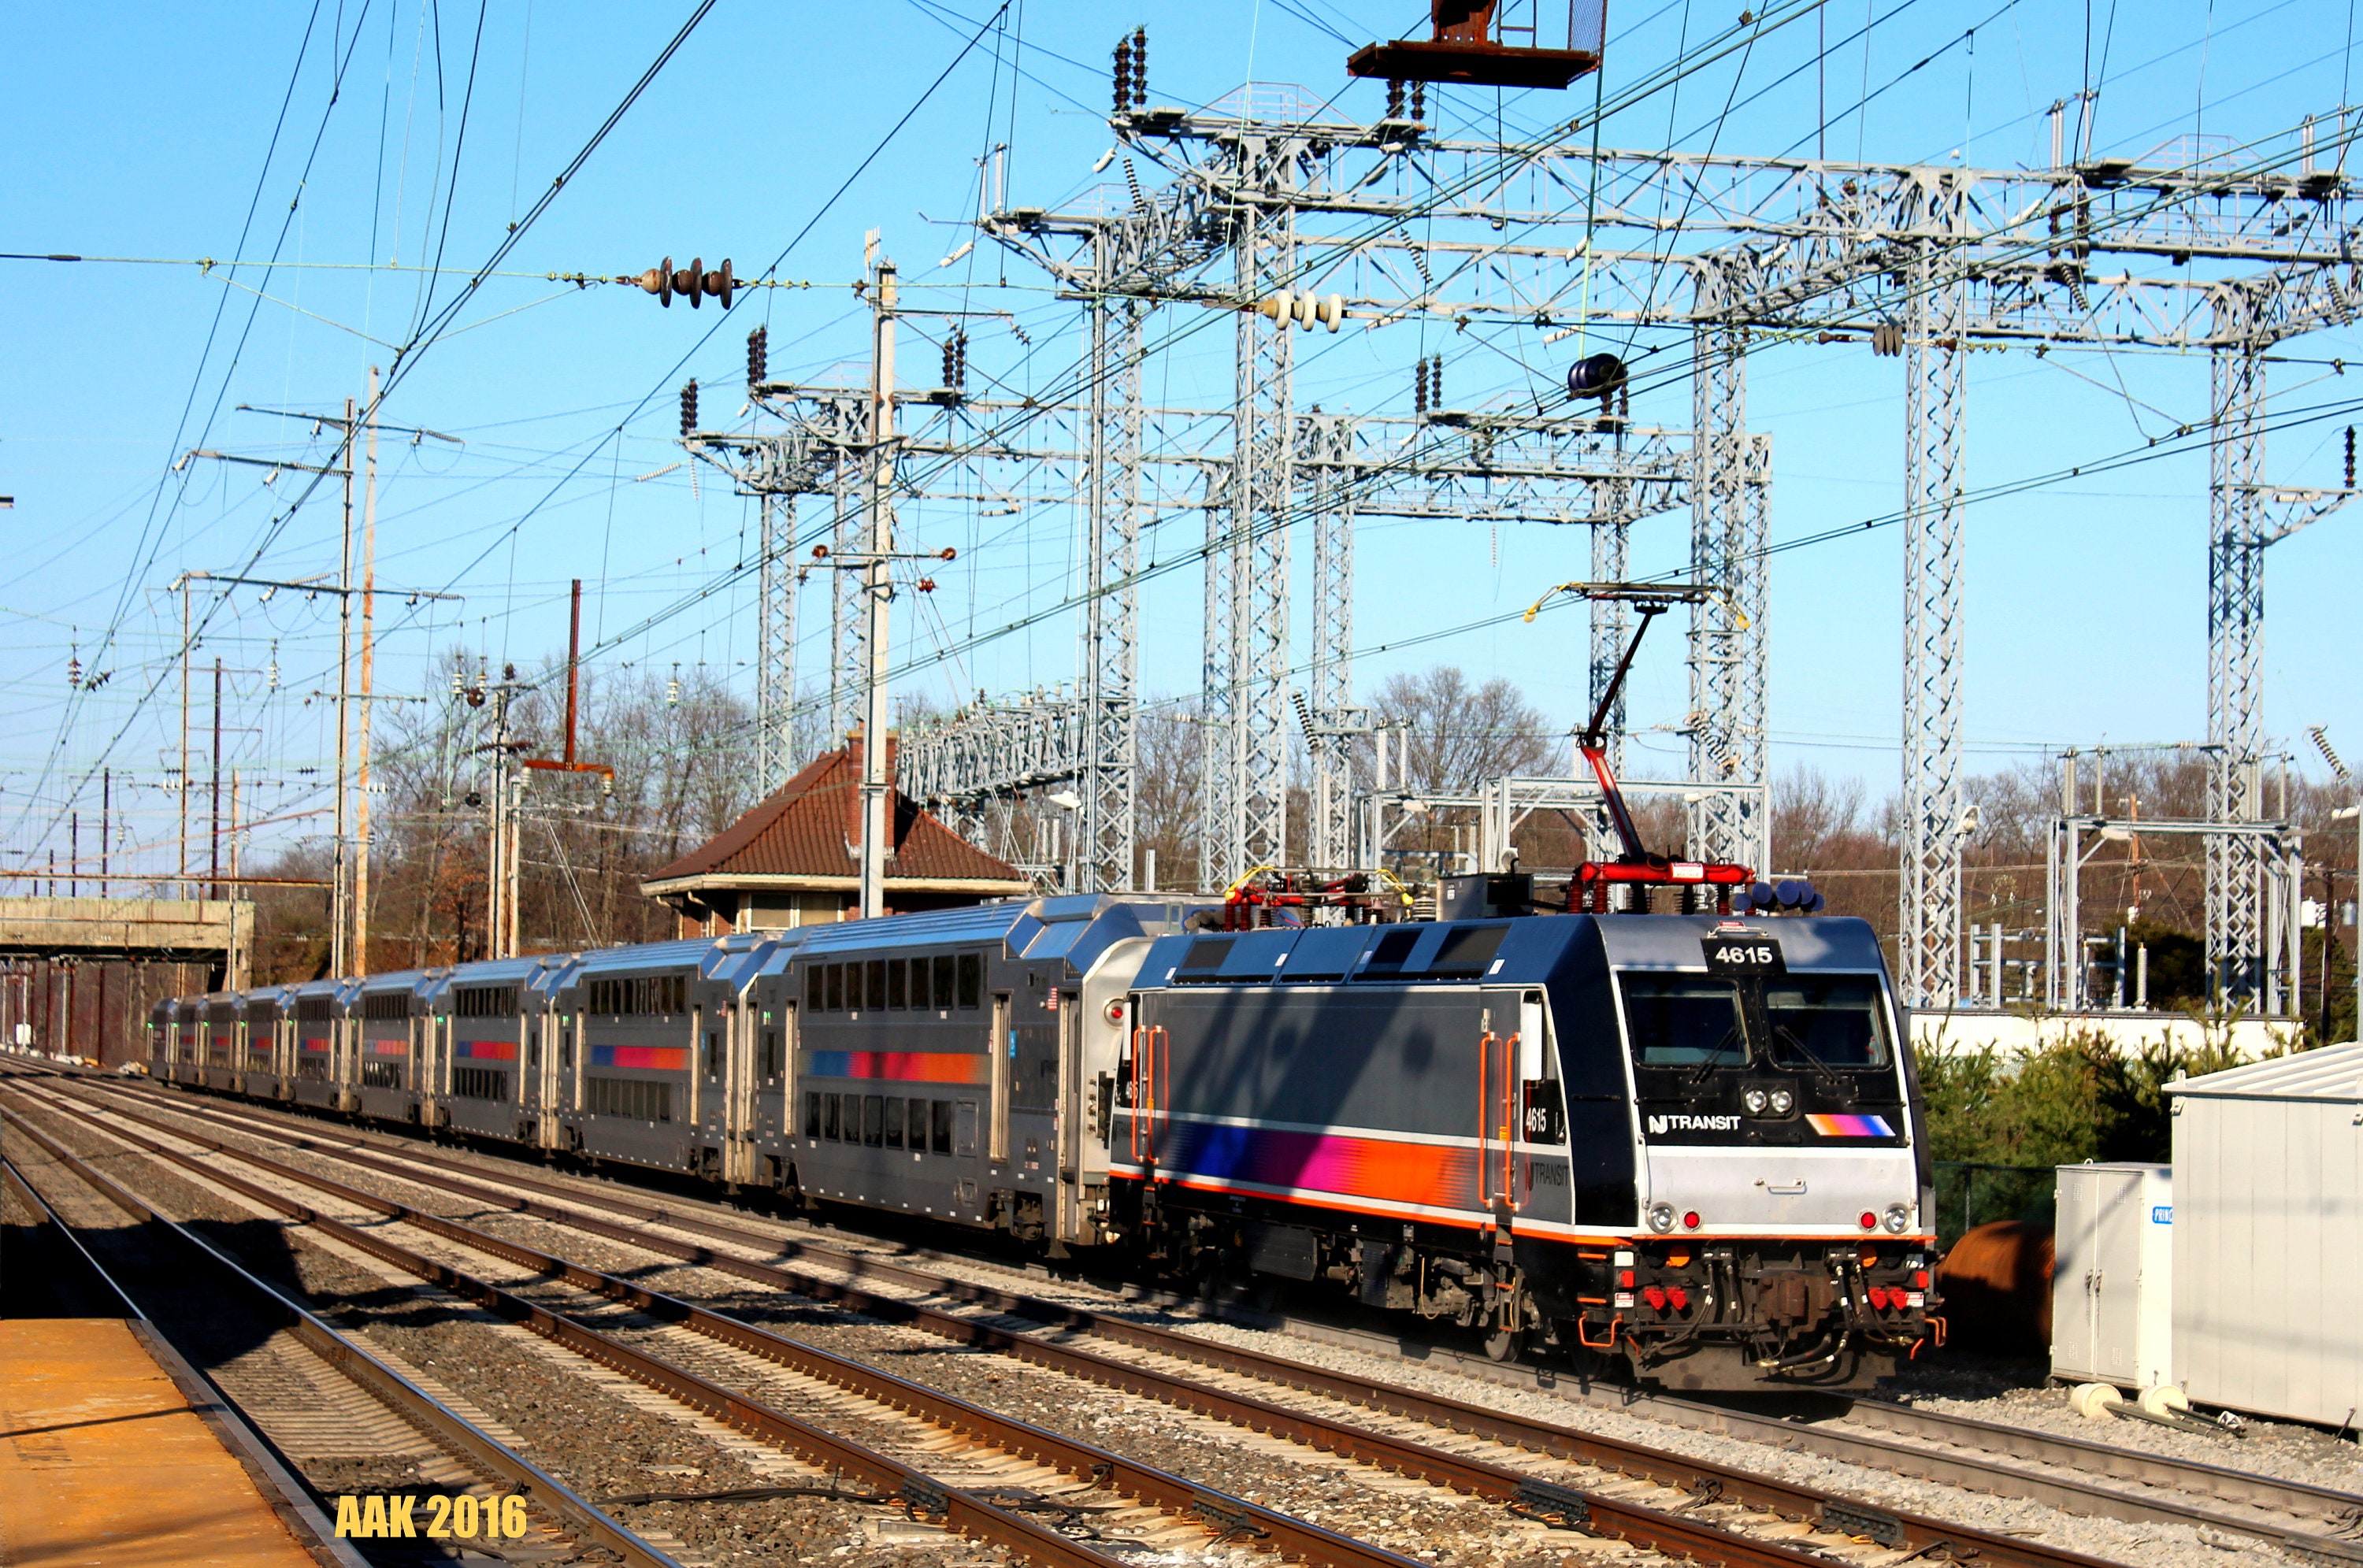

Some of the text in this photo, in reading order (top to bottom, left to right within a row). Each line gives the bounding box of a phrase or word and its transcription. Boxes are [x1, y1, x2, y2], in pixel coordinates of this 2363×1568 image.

[1716, 947, 1773, 964] 4615
[1126, 1081, 1138, 1099] 465
[1526, 1107, 1546, 1132] 4615
[1668, 1115, 1742, 1131] TRANSIT
[1534, 1162, 1570, 1187] TRANSIT
